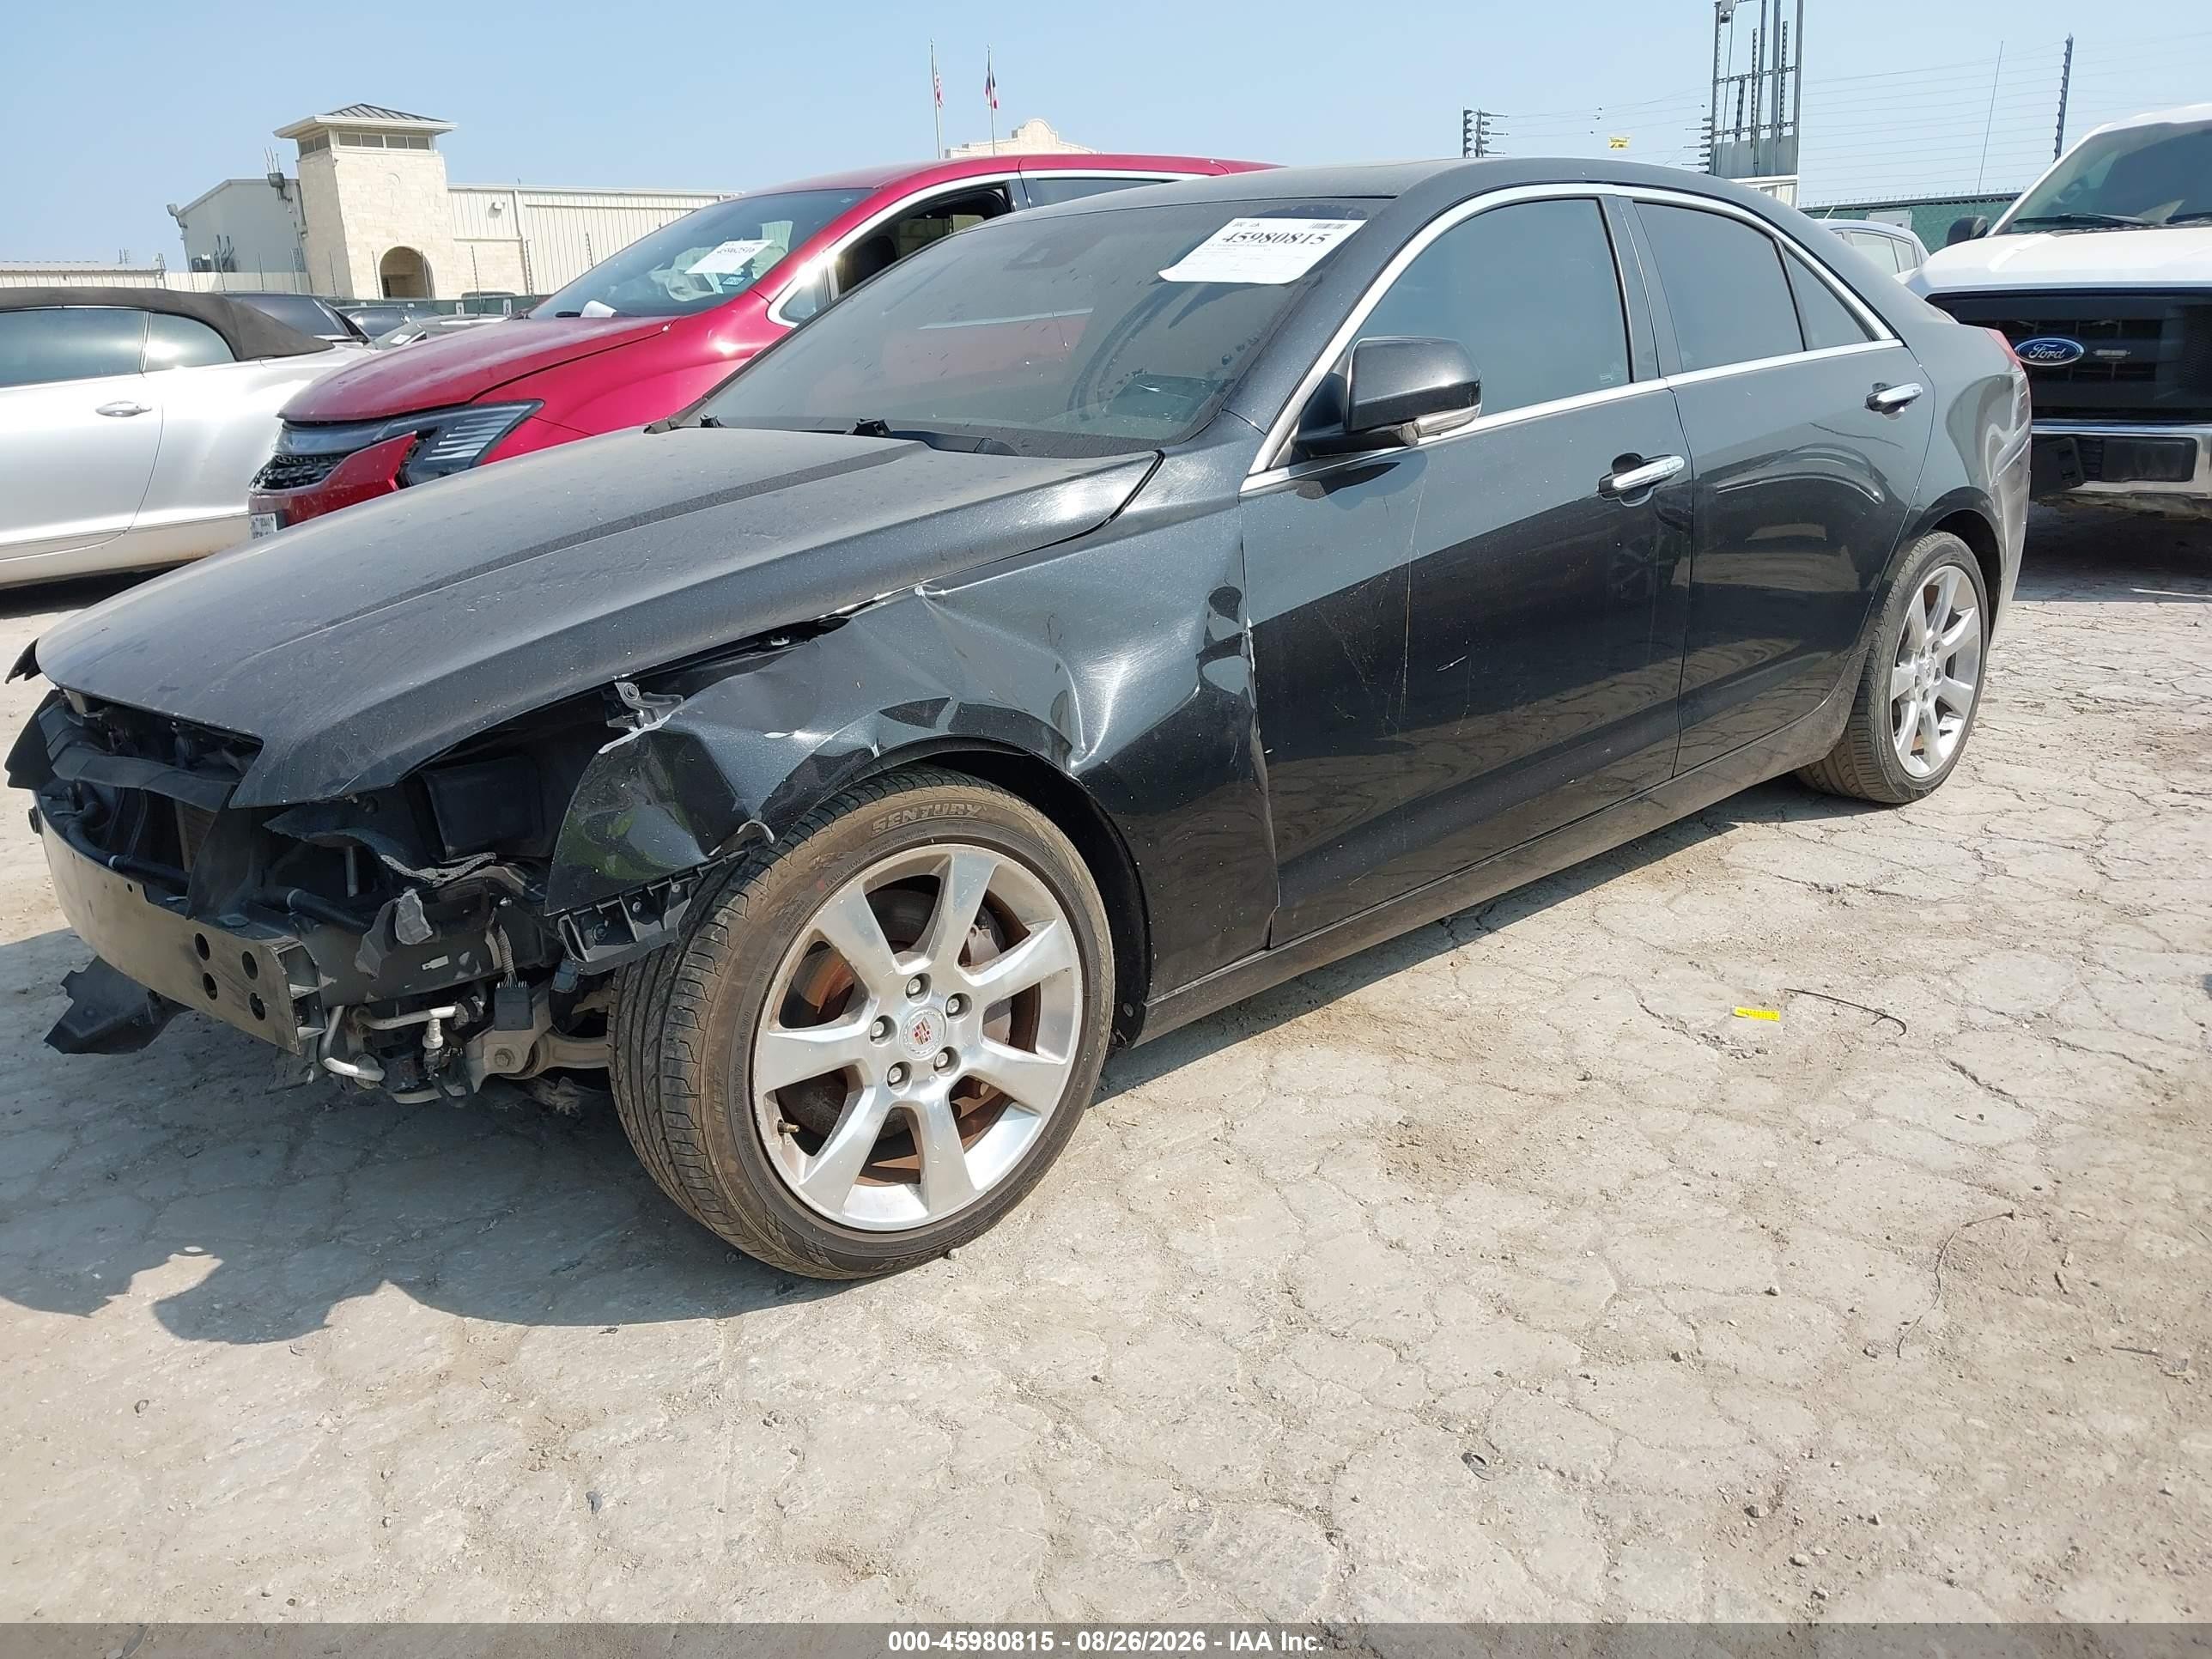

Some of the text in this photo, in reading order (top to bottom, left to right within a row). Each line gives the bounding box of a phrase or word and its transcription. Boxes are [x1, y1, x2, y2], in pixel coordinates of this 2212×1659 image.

[1222, 231, 1332, 245] 45980815
[2028, 343, 2067, 359] Ford
[872, 803, 983, 835] SENTURY
